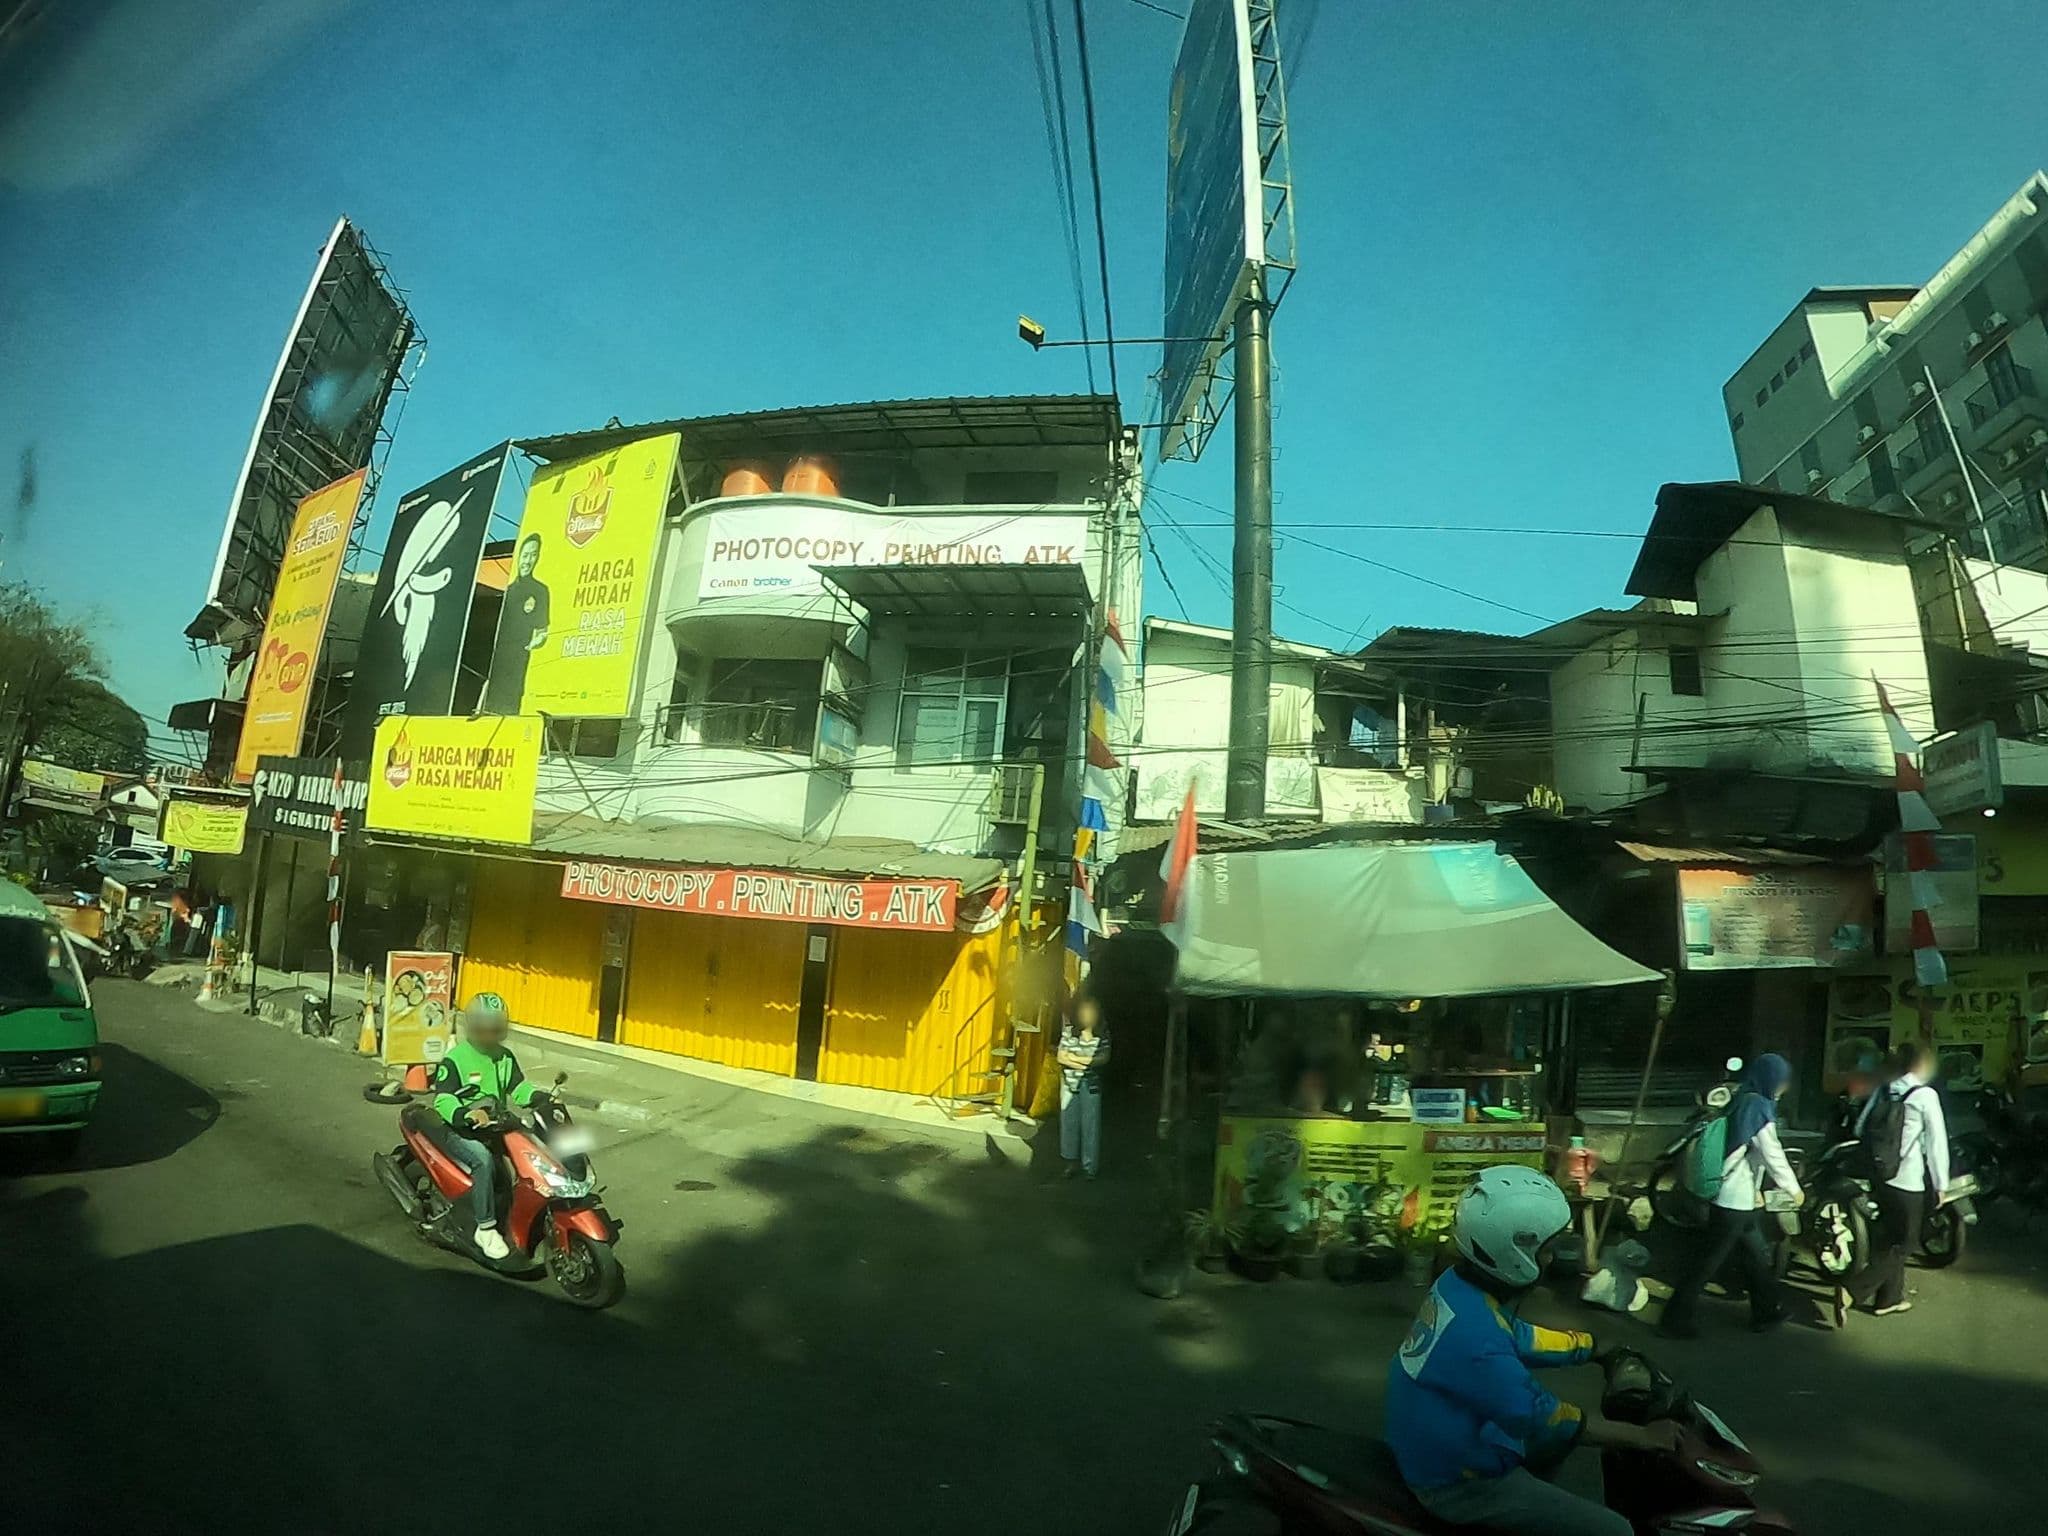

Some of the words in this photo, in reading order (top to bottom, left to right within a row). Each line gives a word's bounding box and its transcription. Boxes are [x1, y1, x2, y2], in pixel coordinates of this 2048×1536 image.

[712, 537, 864, 563] PHOTOCOPY
[1023, 545, 1076, 563] ATK
[578, 557, 634, 585] HARGA
[710, 577, 748, 589] Canon
[753, 577, 792, 586] brother
[572, 581, 633, 608] MURAH
[579, 607, 626, 632] RASA
[561, 632, 625, 658] MEWAH
[418, 746, 463, 767] HARGA
[465, 748, 515, 769] MURAH
[416, 767, 451, 788] RASA
[453, 770, 504, 791] MEWAH
[565, 861, 714, 908] PHOTOCOPY
[731, 874, 864, 922] PRINTING
[882, 885, 949, 926] ATK
